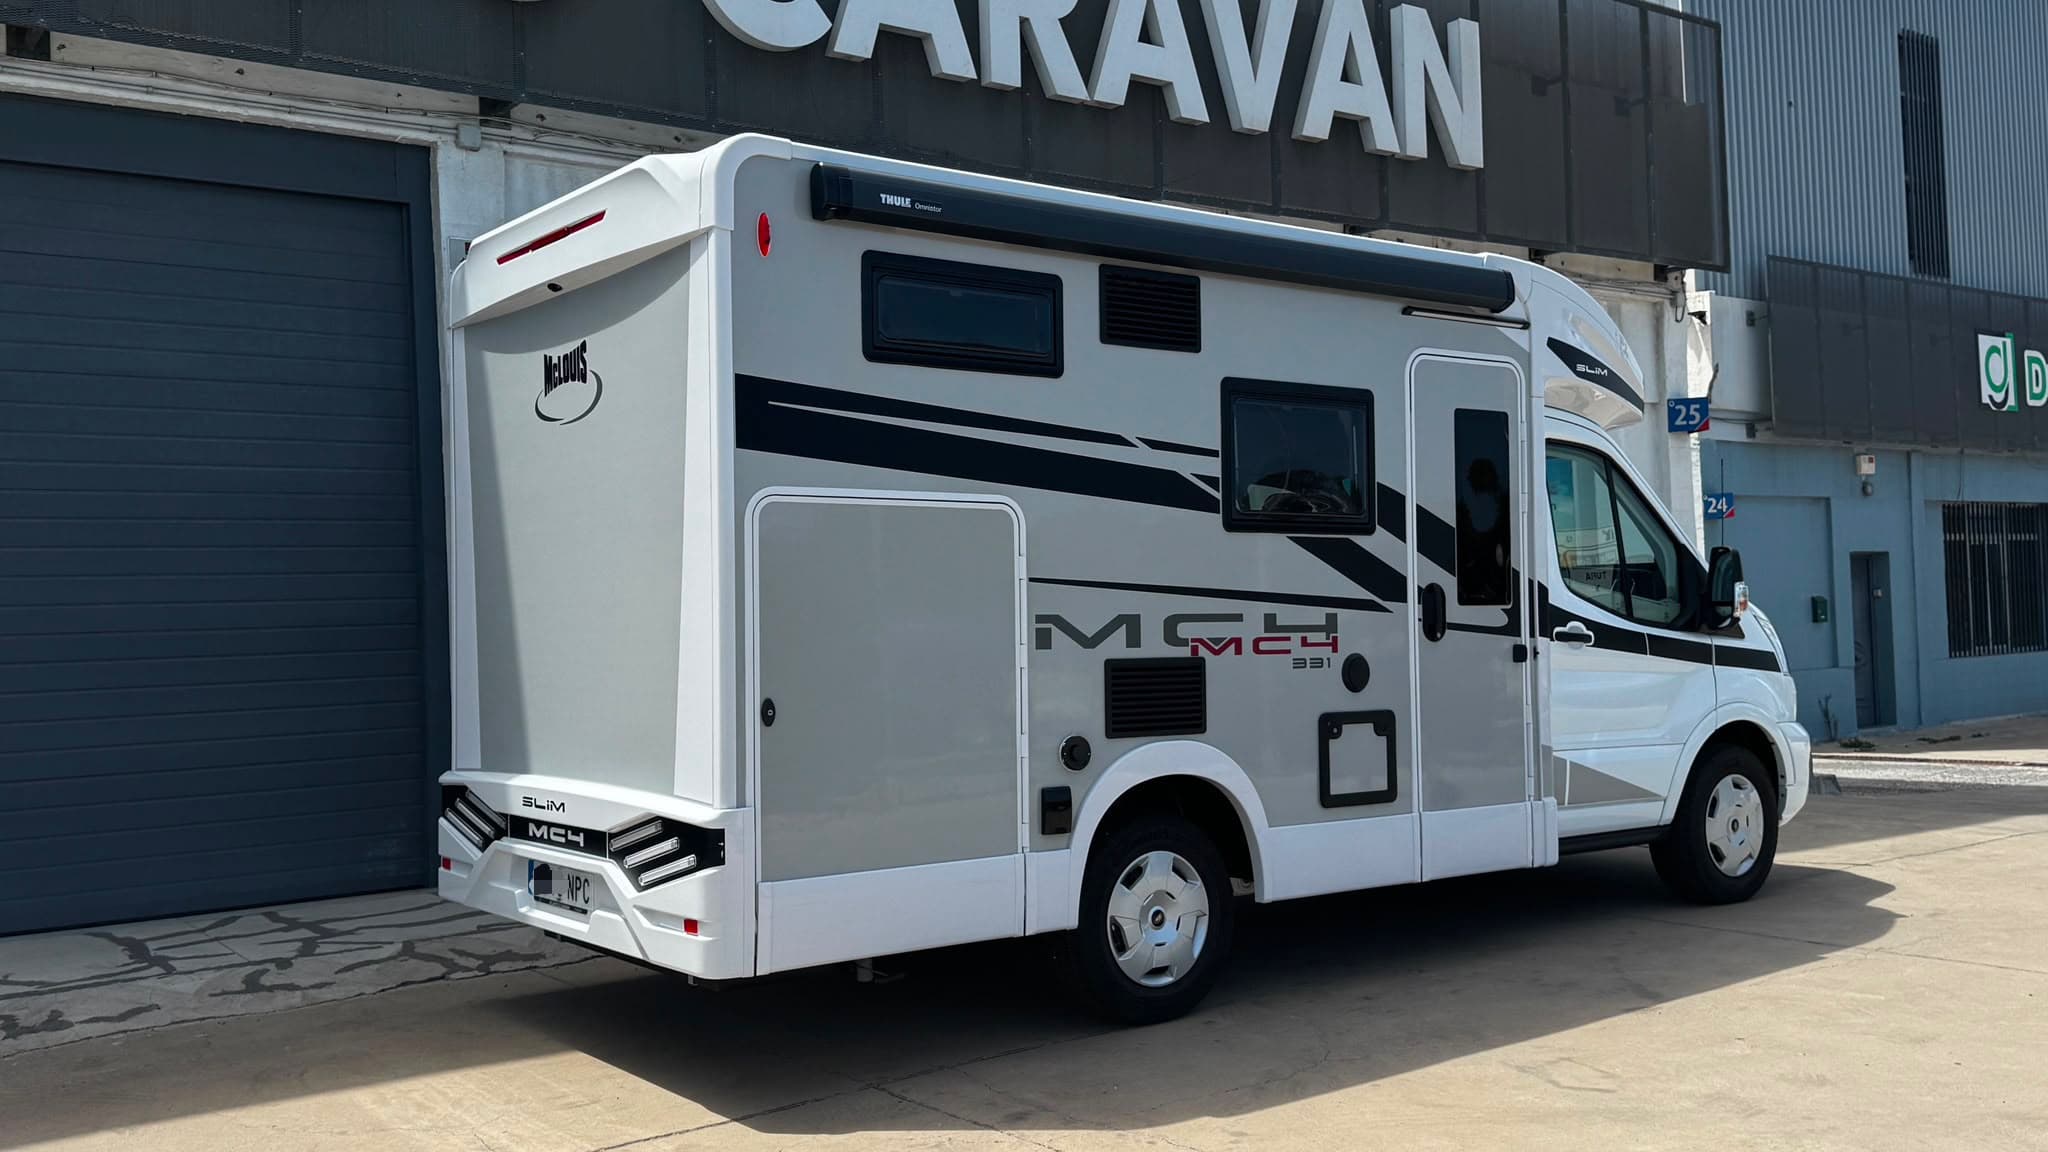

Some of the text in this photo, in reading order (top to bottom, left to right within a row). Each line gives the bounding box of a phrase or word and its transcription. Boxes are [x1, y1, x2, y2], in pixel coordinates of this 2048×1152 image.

[703, 0, 1485, 170] RAVAN
[880, 193, 912, 208] THULE
[2024, 349, 2048, 407] D
[1190, 635, 1339, 657] MC4
[1292, 656, 1331, 670] 331
[528, 822, 585, 848] MC4
[567, 873, 590, 904] NPC
